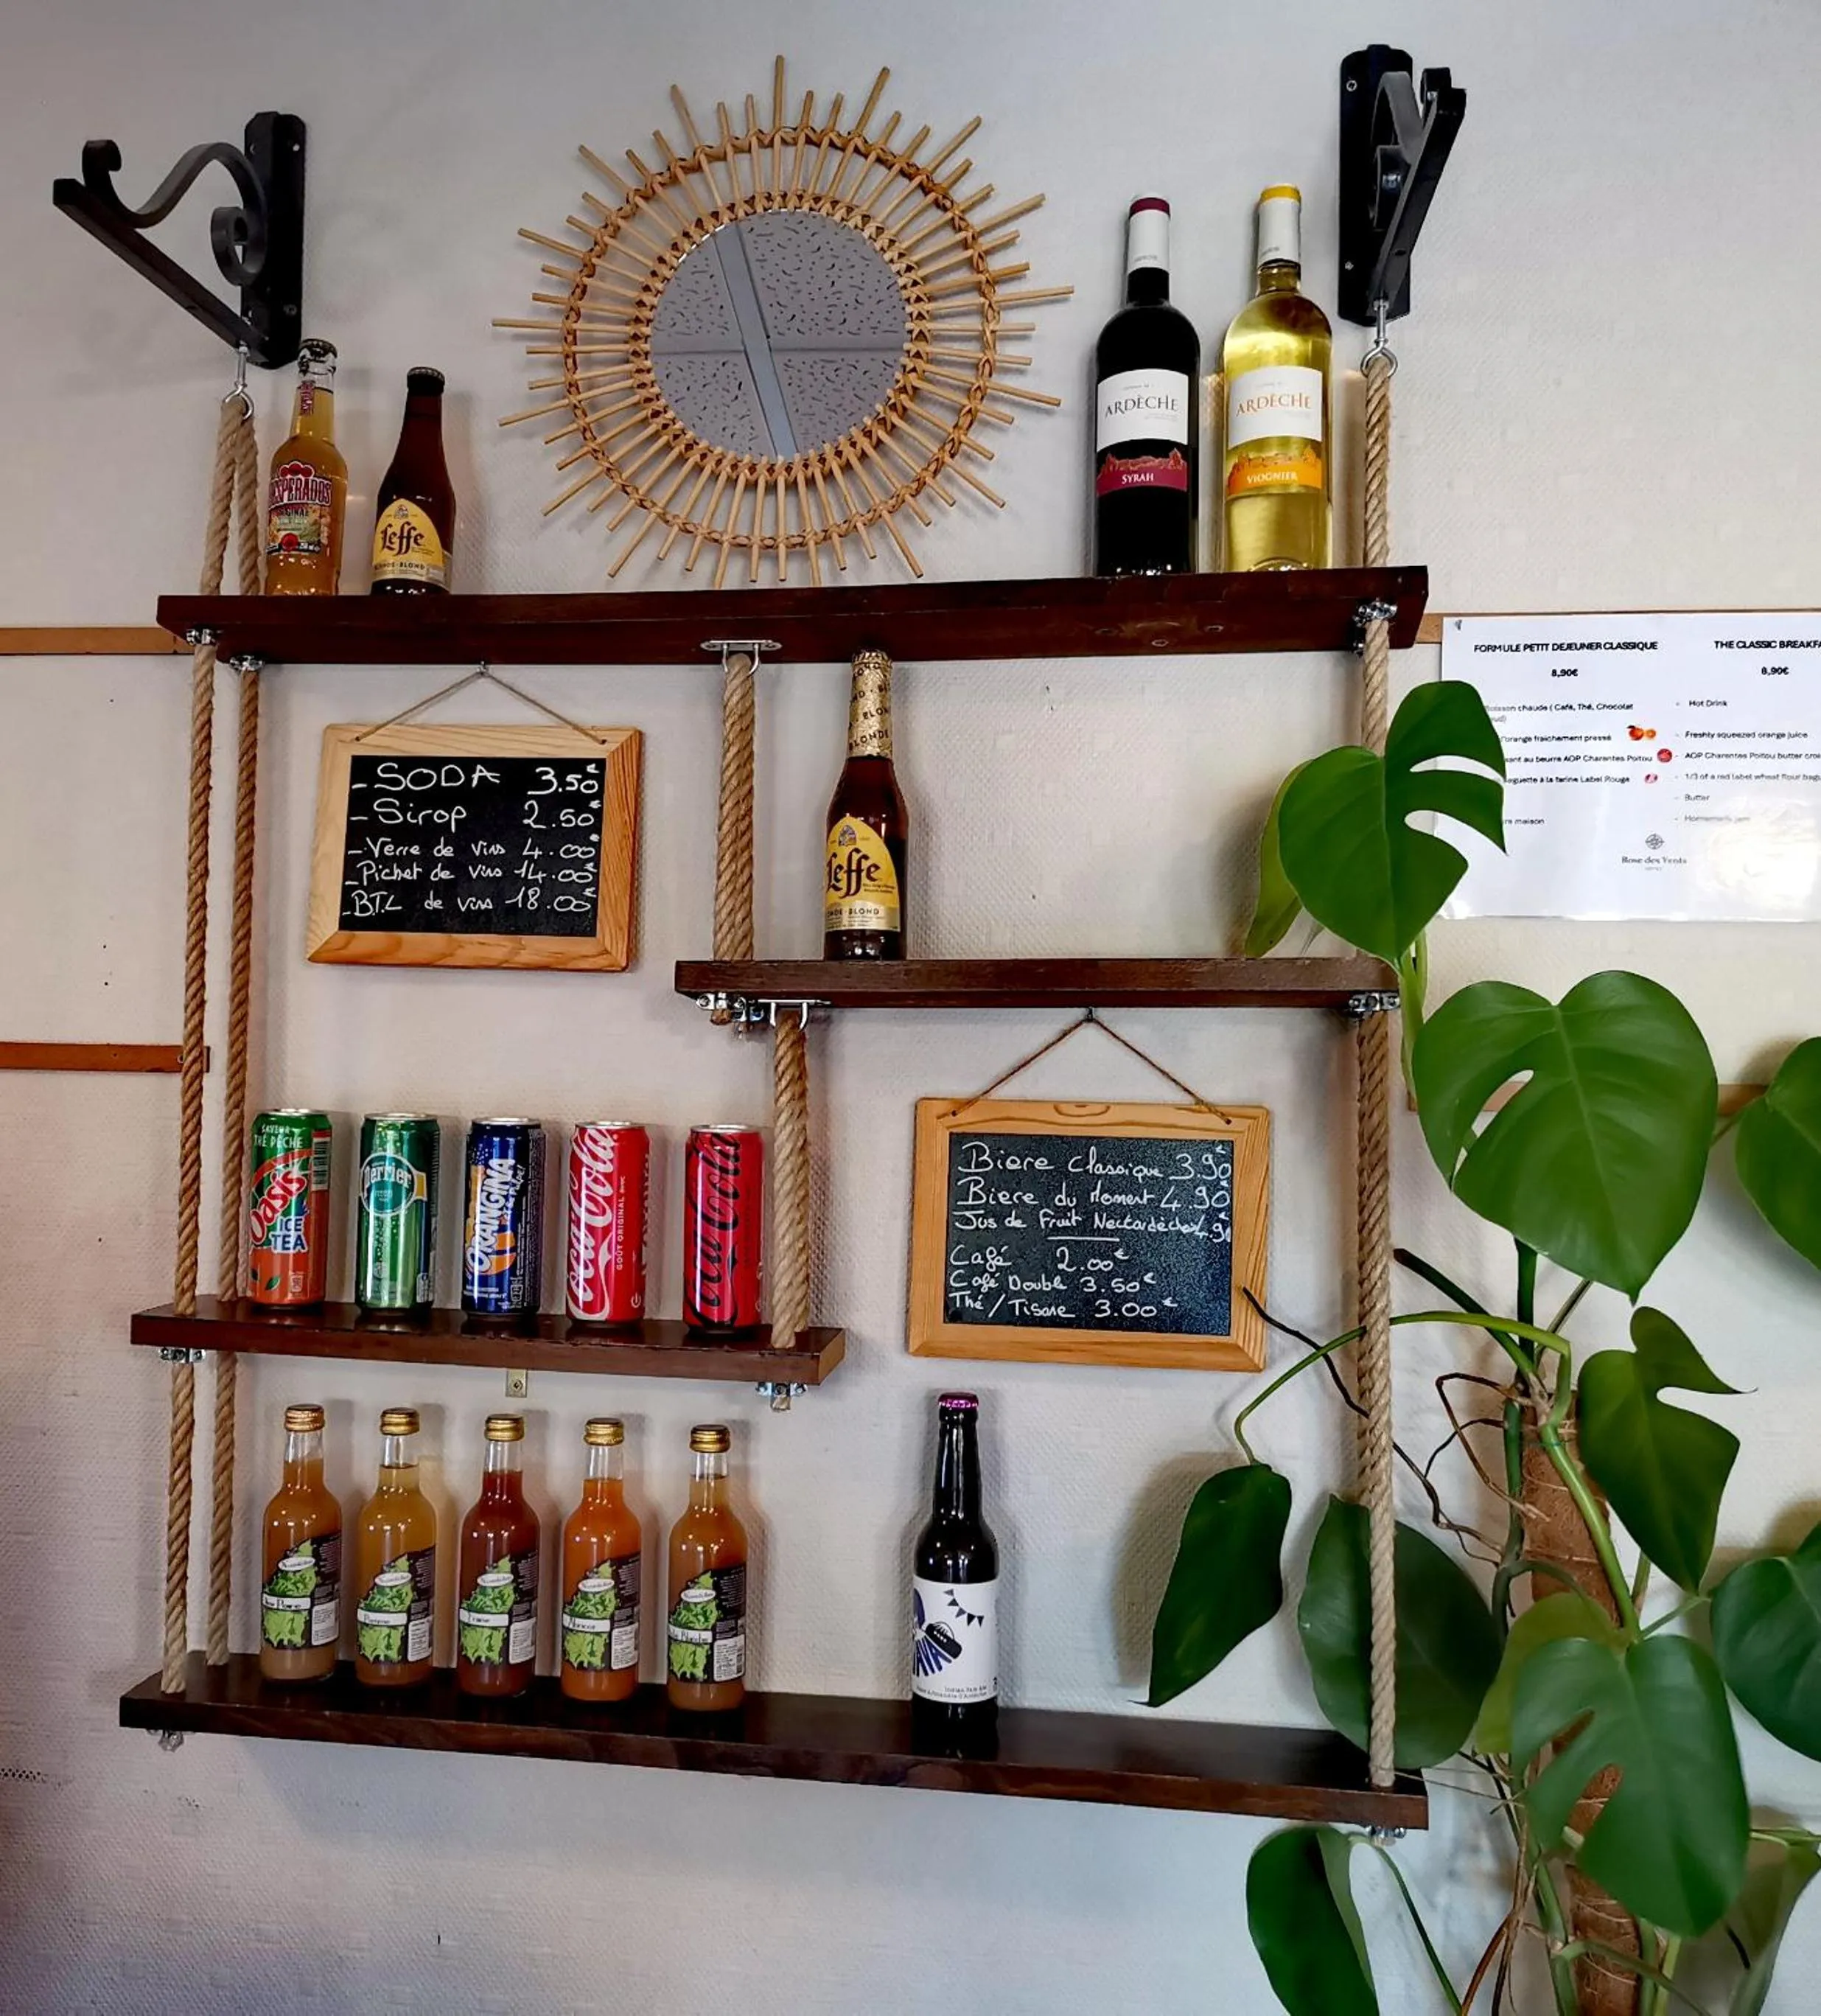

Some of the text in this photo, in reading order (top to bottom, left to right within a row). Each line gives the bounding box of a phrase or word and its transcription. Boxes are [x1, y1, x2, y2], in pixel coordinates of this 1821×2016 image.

[1122, 472, 1155, 485] SYRAH
[1246, 471, 1299, 484] VIOGNIER
[380, 520, 425, 557] Leffe
[1474, 641, 1658, 652] FORMULE PETIT DEJEUNER CLASSIQUE
[1714, 640, 1734, 649] THE
[1736, 640, 1778, 649] CLASSIC
[1596, 702, 1634, 711] Chocolat
[1688, 699, 1728, 708] Hot Drink
[1705, 752, 1748, 760] Charentes
[433, 837, 455, 857] de
[430, 862, 455, 881] de
[424, 888, 444, 909] de
[1055, 1182, 1077, 1207] du
[279, 1217, 304, 1233] ICE
[466, 1158, 515, 1274] ORANGINA
[952, 1210, 997, 1230] Jus
[1004, 1210, 1027, 1228] de
[271, 1233, 307, 1252] TEA
[950, 1245, 1013, 1269] Café
[949, 1269, 999, 1291] Café
[1007, 1274, 1068, 1292] Double
[949, 1291, 983, 1311] Thé
[1007, 1298, 1076, 1319] Tisane
